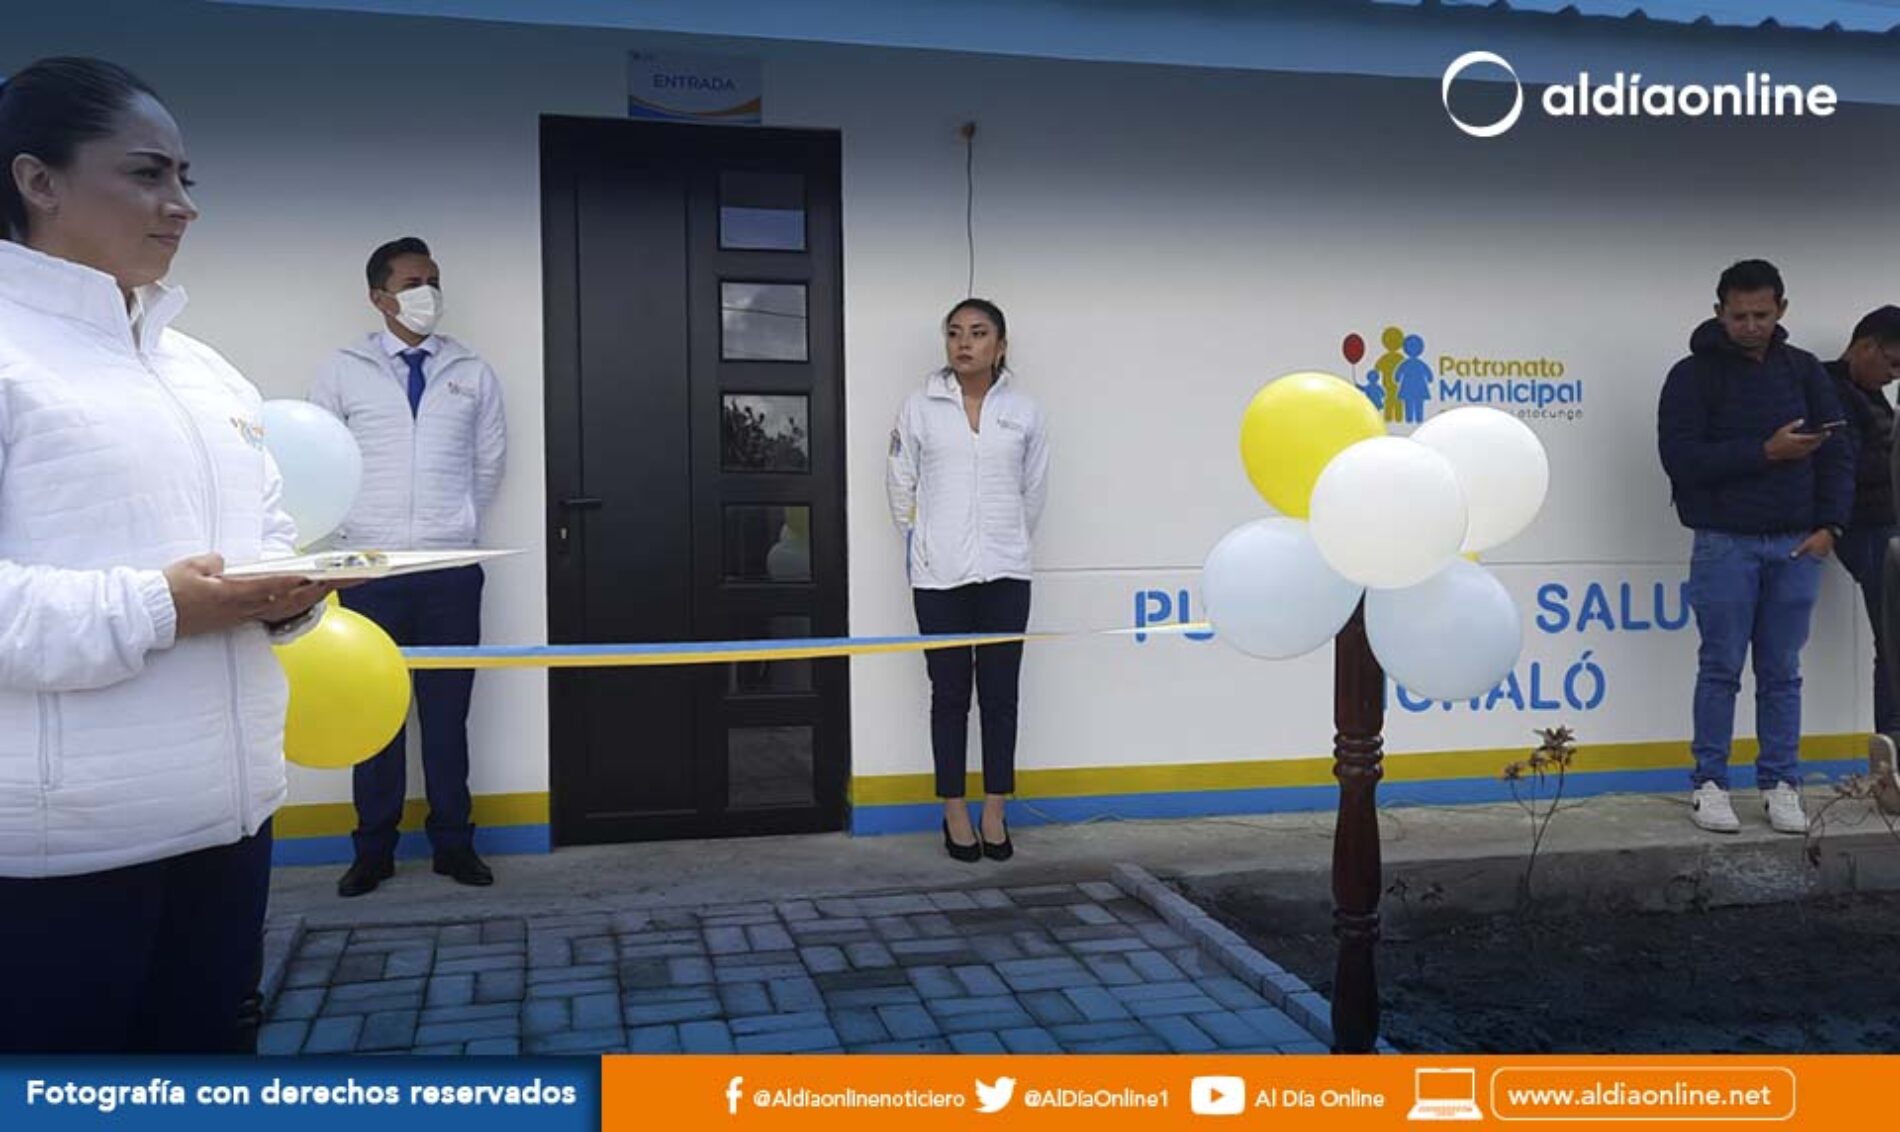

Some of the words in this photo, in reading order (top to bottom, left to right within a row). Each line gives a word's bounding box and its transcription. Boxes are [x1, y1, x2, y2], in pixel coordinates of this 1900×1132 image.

[653, 74, 736, 91] ENTRADA
[1438, 356, 1565, 378] Patronato
[1439, 379, 1583, 408] Municipal
